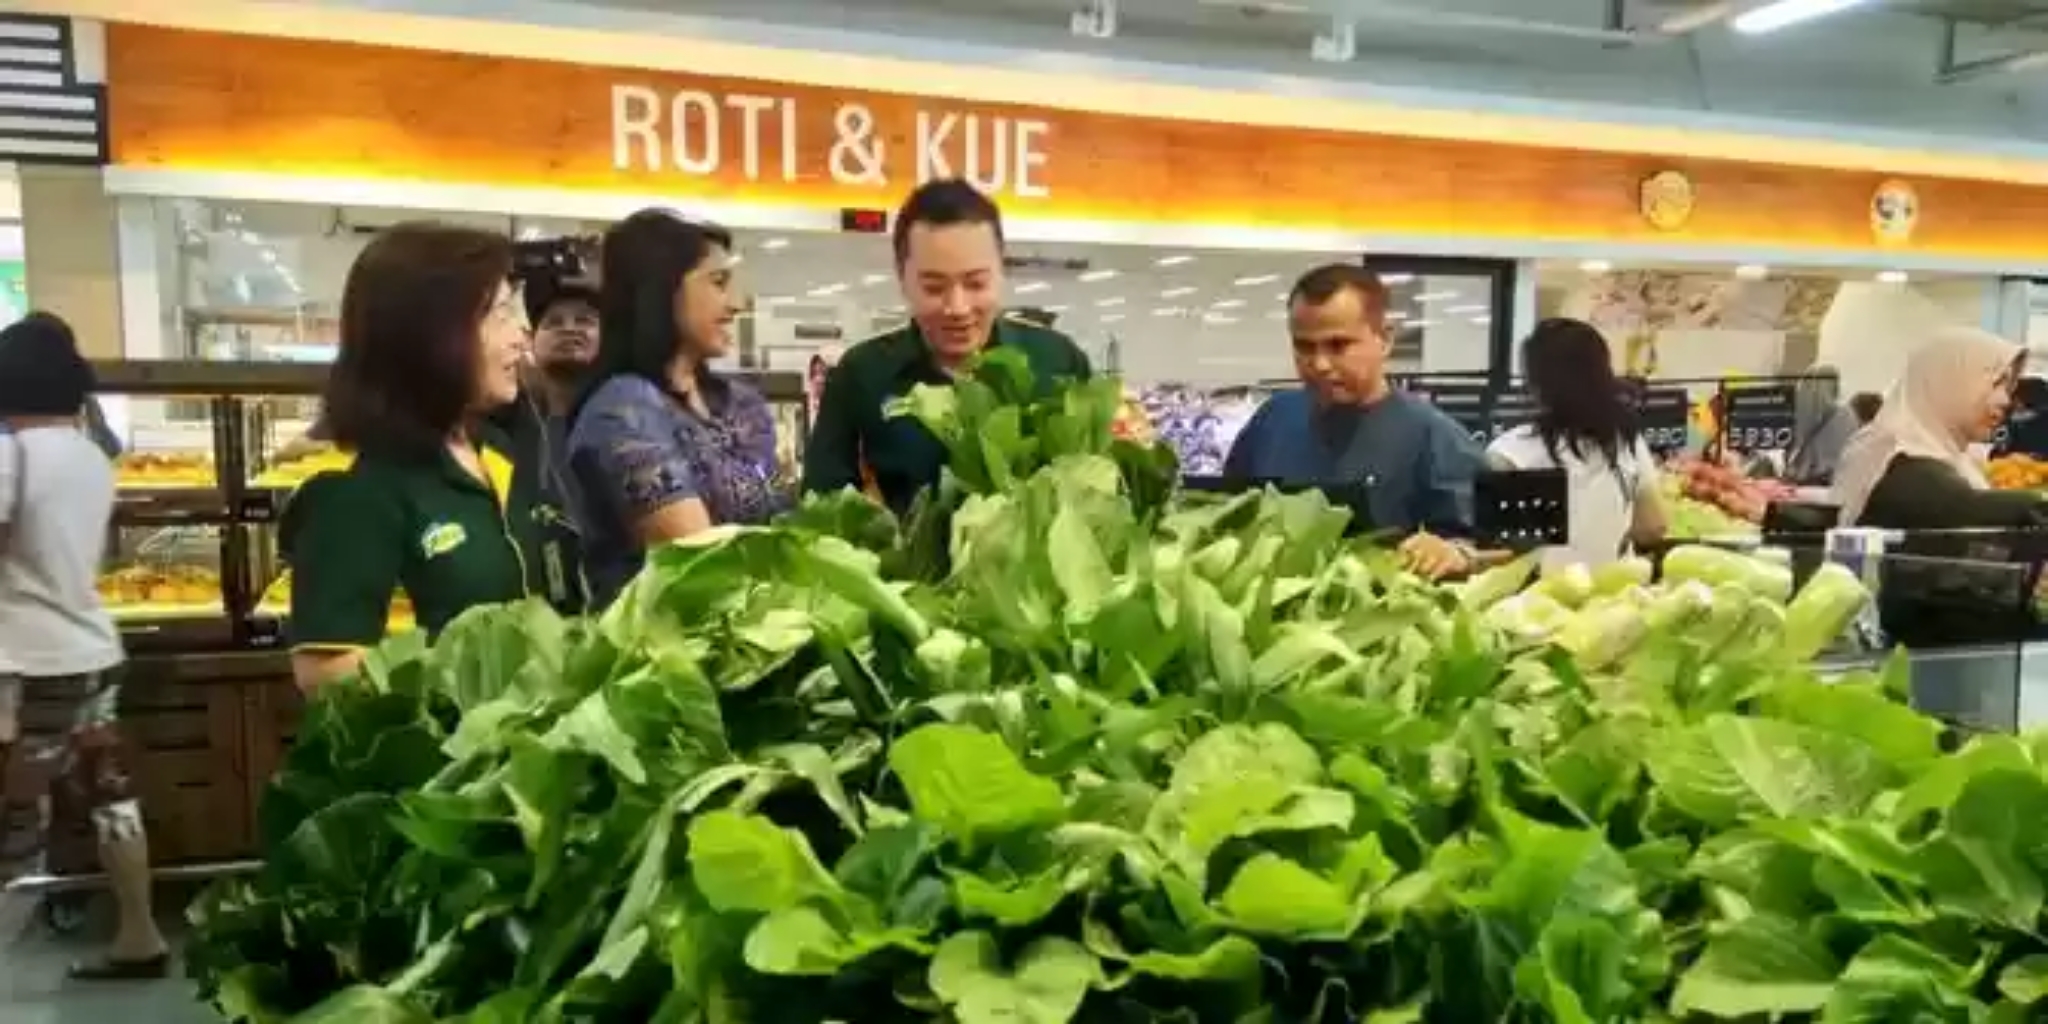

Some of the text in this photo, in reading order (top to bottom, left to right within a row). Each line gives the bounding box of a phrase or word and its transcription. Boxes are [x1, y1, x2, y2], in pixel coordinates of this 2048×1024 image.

[611, 84, 1049, 197] ROTI & KUE
